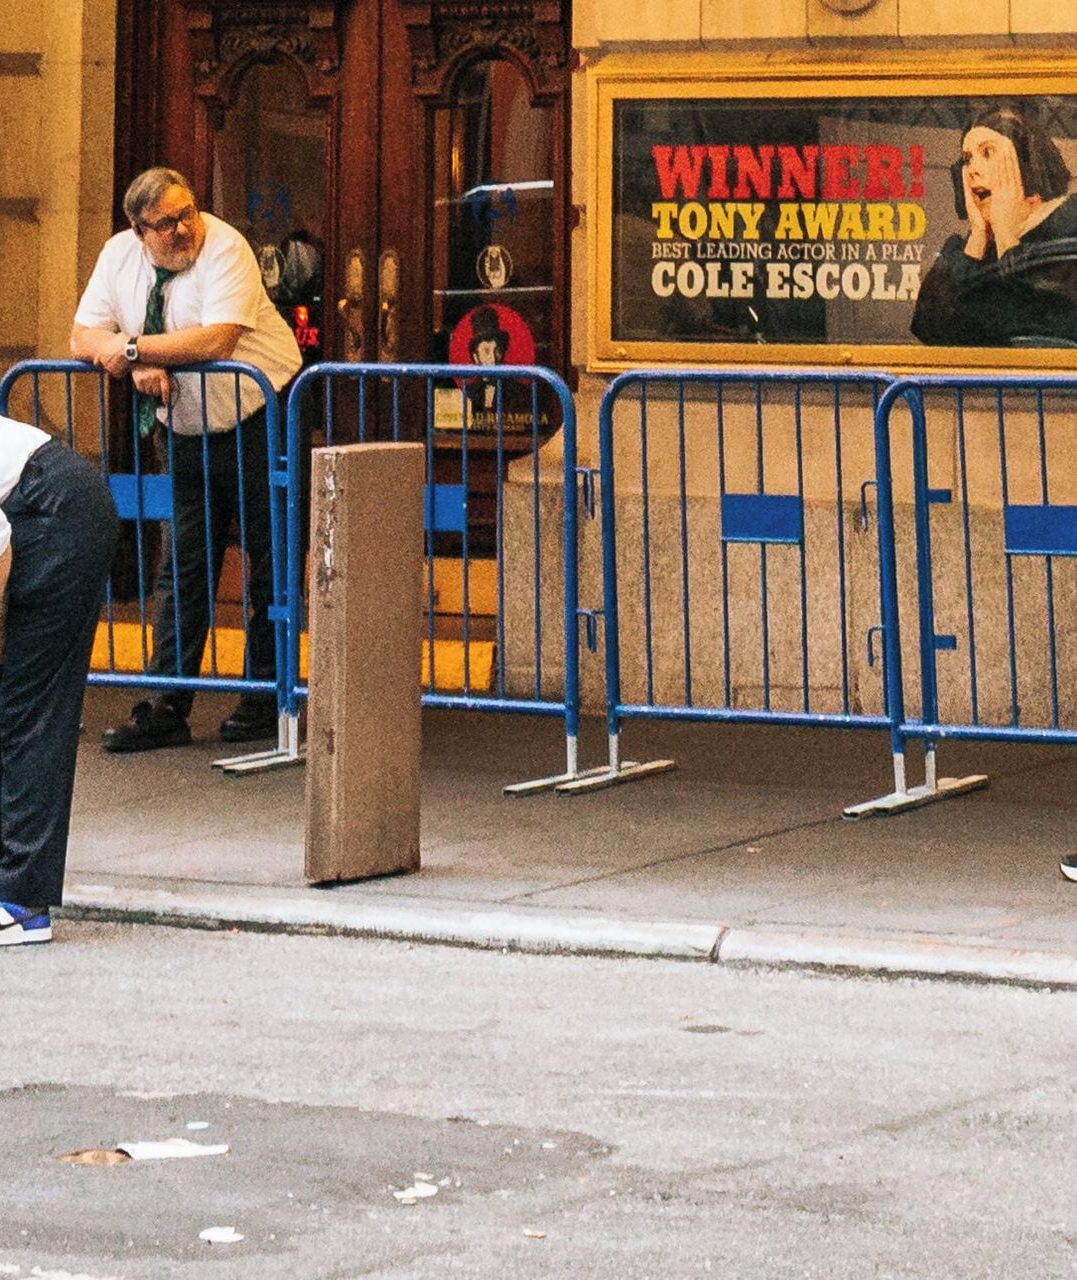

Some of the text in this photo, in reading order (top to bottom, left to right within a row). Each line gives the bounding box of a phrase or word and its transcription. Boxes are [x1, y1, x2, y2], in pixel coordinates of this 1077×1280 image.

[651, 144, 925, 200] WINNER!
[651, 202, 927, 240] TONY AWARD
[652, 243, 924, 261] BEST LEADING ACTOR IN A PLAY
[651, 262, 922, 301] COLE ESCOLA
